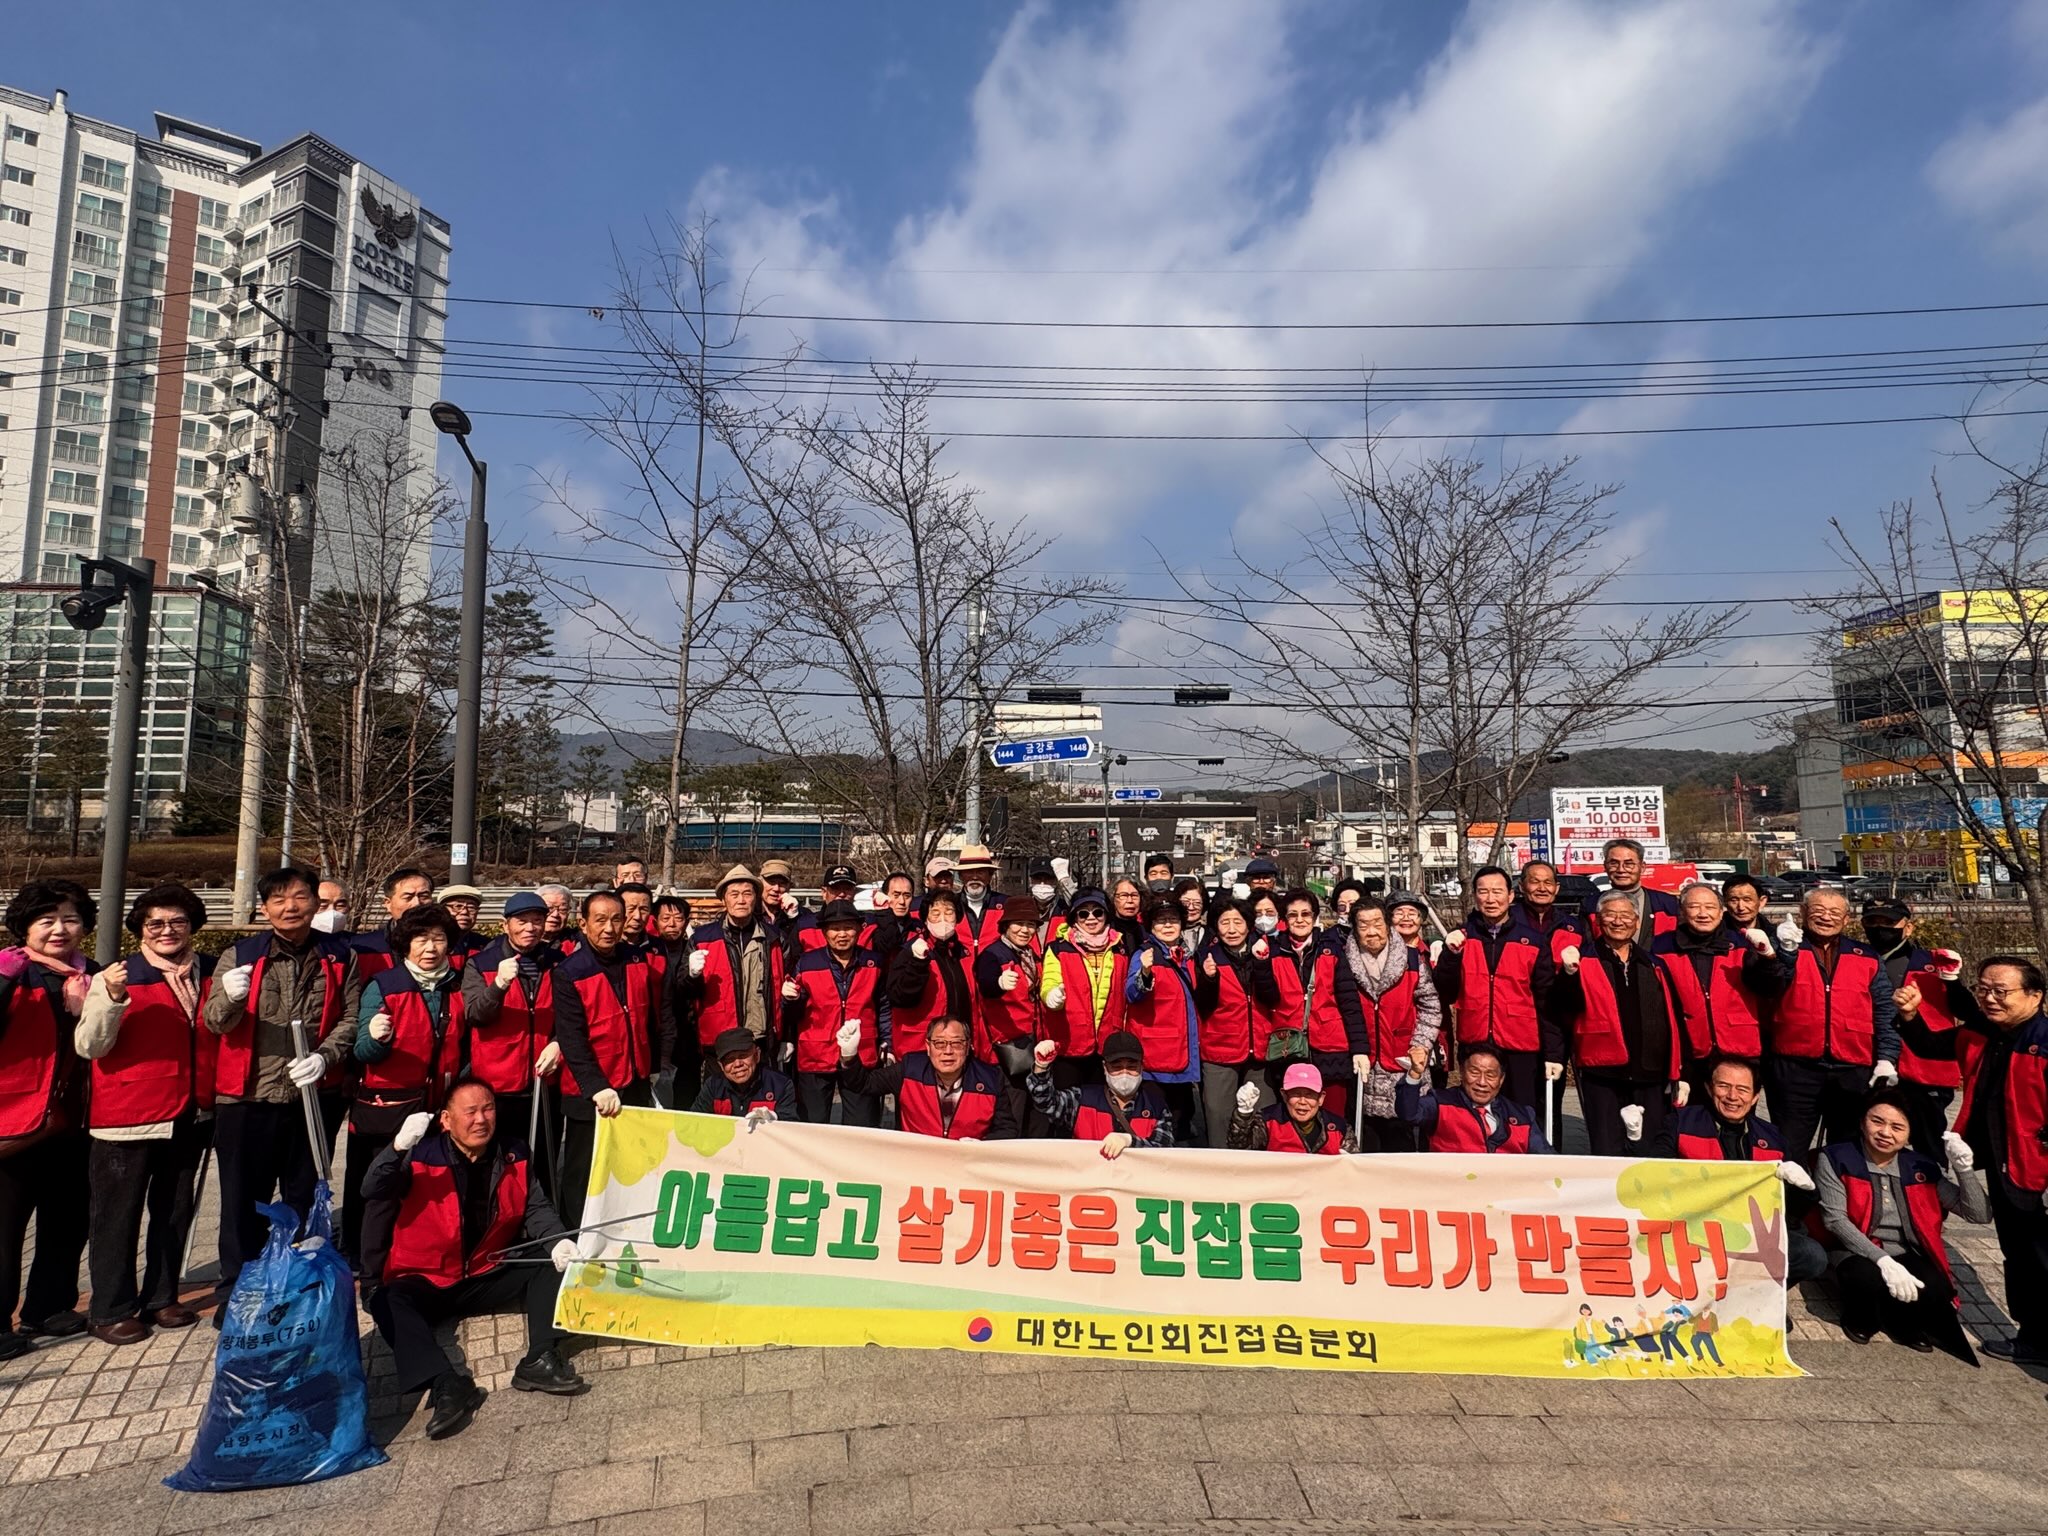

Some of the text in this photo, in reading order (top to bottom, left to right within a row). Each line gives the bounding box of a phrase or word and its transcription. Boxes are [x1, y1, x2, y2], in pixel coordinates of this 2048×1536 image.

[353, 234, 414, 278] LOTTE
[352, 254, 413, 294] CASTLE
[997, 750, 1014, 759] 1444
[1025, 741, 1056, 754] 금강로
[1069, 743, 1087, 752] 1448
[1585, 795, 1660, 811] 두부한상
[1585, 811, 1659, 826] 10,000원
[652, 1169, 1729, 1301] 아름답고 살기좋은 진접읍 우리가 만들자!
